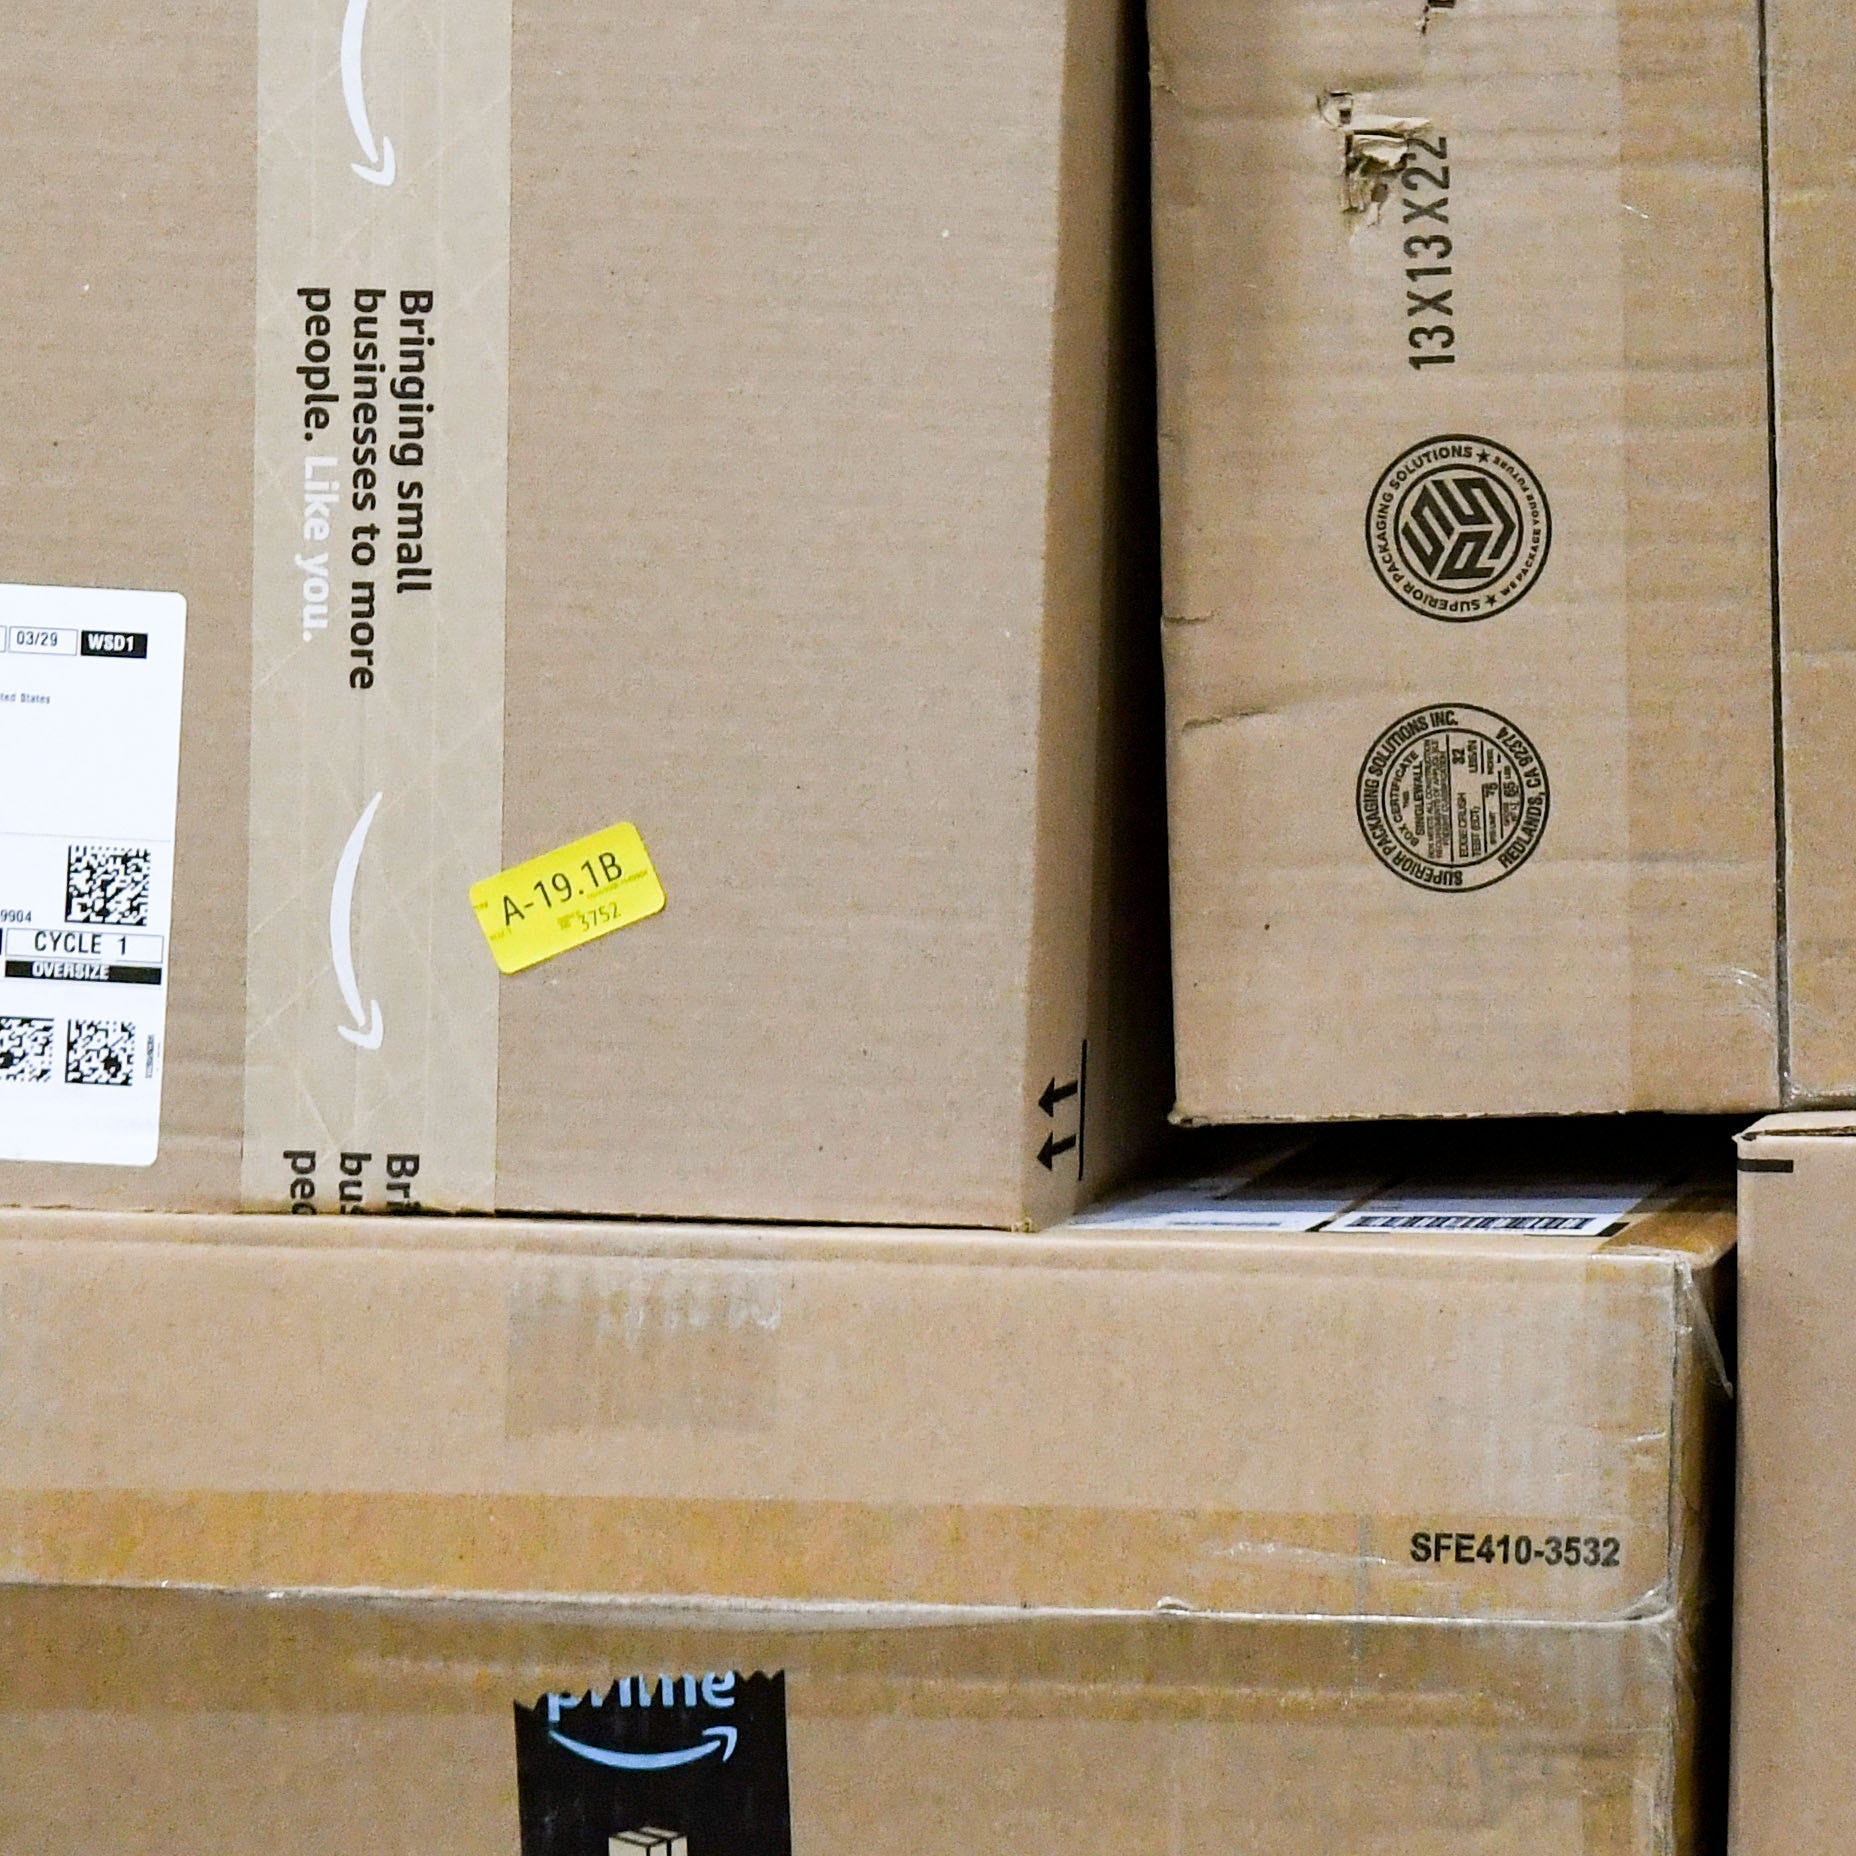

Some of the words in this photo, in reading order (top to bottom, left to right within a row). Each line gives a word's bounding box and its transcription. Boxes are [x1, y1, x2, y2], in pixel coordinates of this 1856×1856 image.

[296, 287, 339, 442] people.
[390, 289, 435, 467] Bringing
[352, 288, 386, 512] businesses
[1389, 445, 1473, 490] SOLUTIONS
[303, 456, 340, 541] Like
[351, 522, 380, 566] to
[397, 480, 433, 594] small
[1375, 492, 1405, 584] PACKAGING
[1516, 528, 1542, 581] PACKAGE
[294, 552, 330, 643] you.
[1403, 580, 1481, 613] SUPERIOR
[16, 630, 58, 647] 03/29
[87, 633, 135, 652] WSD1
[349, 581, 375, 690] more
[1368, 715, 1429, 778] SOLUTIONS
[1430, 709, 1459, 728] INC.
[1495, 726, 1534, 766] 92374
[1524, 767, 1542, 789] CA
[1363, 778, 1398, 856] PACKAGING
[1497, 792, 1546, 869] REDLANDS,
[501, 851, 622, 927] A-19.1B
[1393, 850, 1464, 886] SUPERIOR
[32, 961, 110, 981] OVERSIZE
[34, 930, 103, 955] CYCLE
[116, 935, 128, 956] 1
[1410, 1532, 1621, 1568] SFE410-3532
